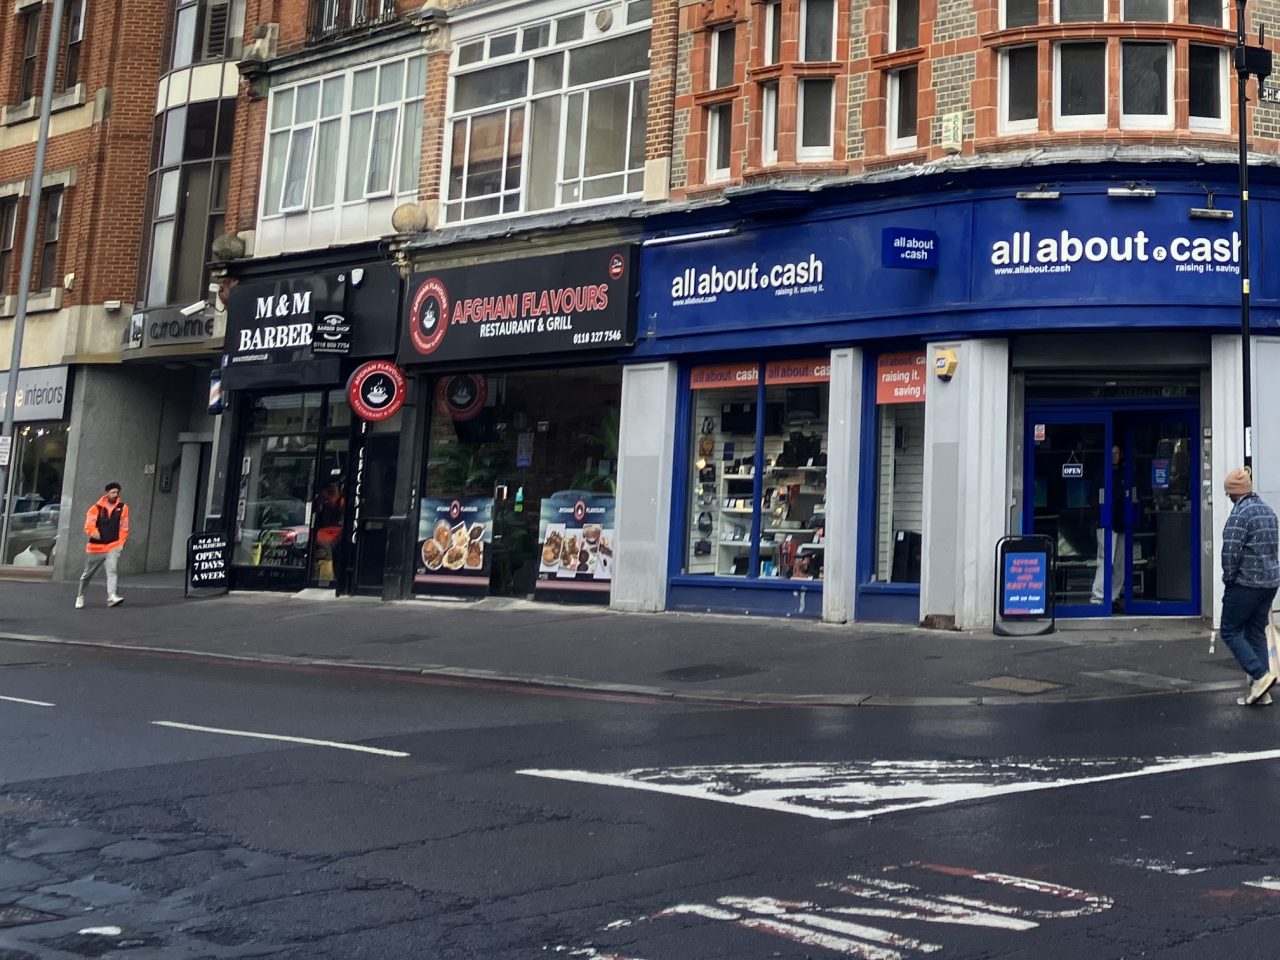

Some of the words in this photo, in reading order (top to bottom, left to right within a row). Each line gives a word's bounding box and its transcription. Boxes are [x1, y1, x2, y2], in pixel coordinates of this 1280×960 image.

[893, 236, 905, 247] all
[906, 237, 933, 249] about
[991, 232, 1030, 264] all
[994, 263, 1071, 275] www.allabout.cash
[1175, 263, 1204, 274] raising
[1205, 263, 1214, 271] it.
[1215, 264, 1240, 274] saving
[671, 268, 695, 297] all
[775, 287, 793, 296] raising
[800, 285, 817, 295] saving
[255, 296, 274, 320] M
[275, 294, 289, 316] &
[291, 291, 312, 315] M
[451, 293, 518, 325] AFGHAN
[521, 283, 609, 318] FLAVOURS
[480, 318, 536, 338] RESTAURANT
[538, 317, 544, 332] &
[546, 315, 572, 331] GRILL
[238, 323, 313, 351] BARBER
[573, 332, 589, 344] 0118
[590, 331, 603, 343] 327
[604, 330, 621, 342] 7546
[355, 364, 377, 385] AFGHAN
[377, 363, 403, 386] FLAVOURS
[882, 371, 909, 383] raising
[911, 369, 920, 380] it.
[24, 381, 63, 405] interiors
[894, 385, 921, 397] saving
[195, 551, 222, 561] OPEN
[201, 560, 224, 570] DAYS
[200, 571, 225, 580] WEEK
